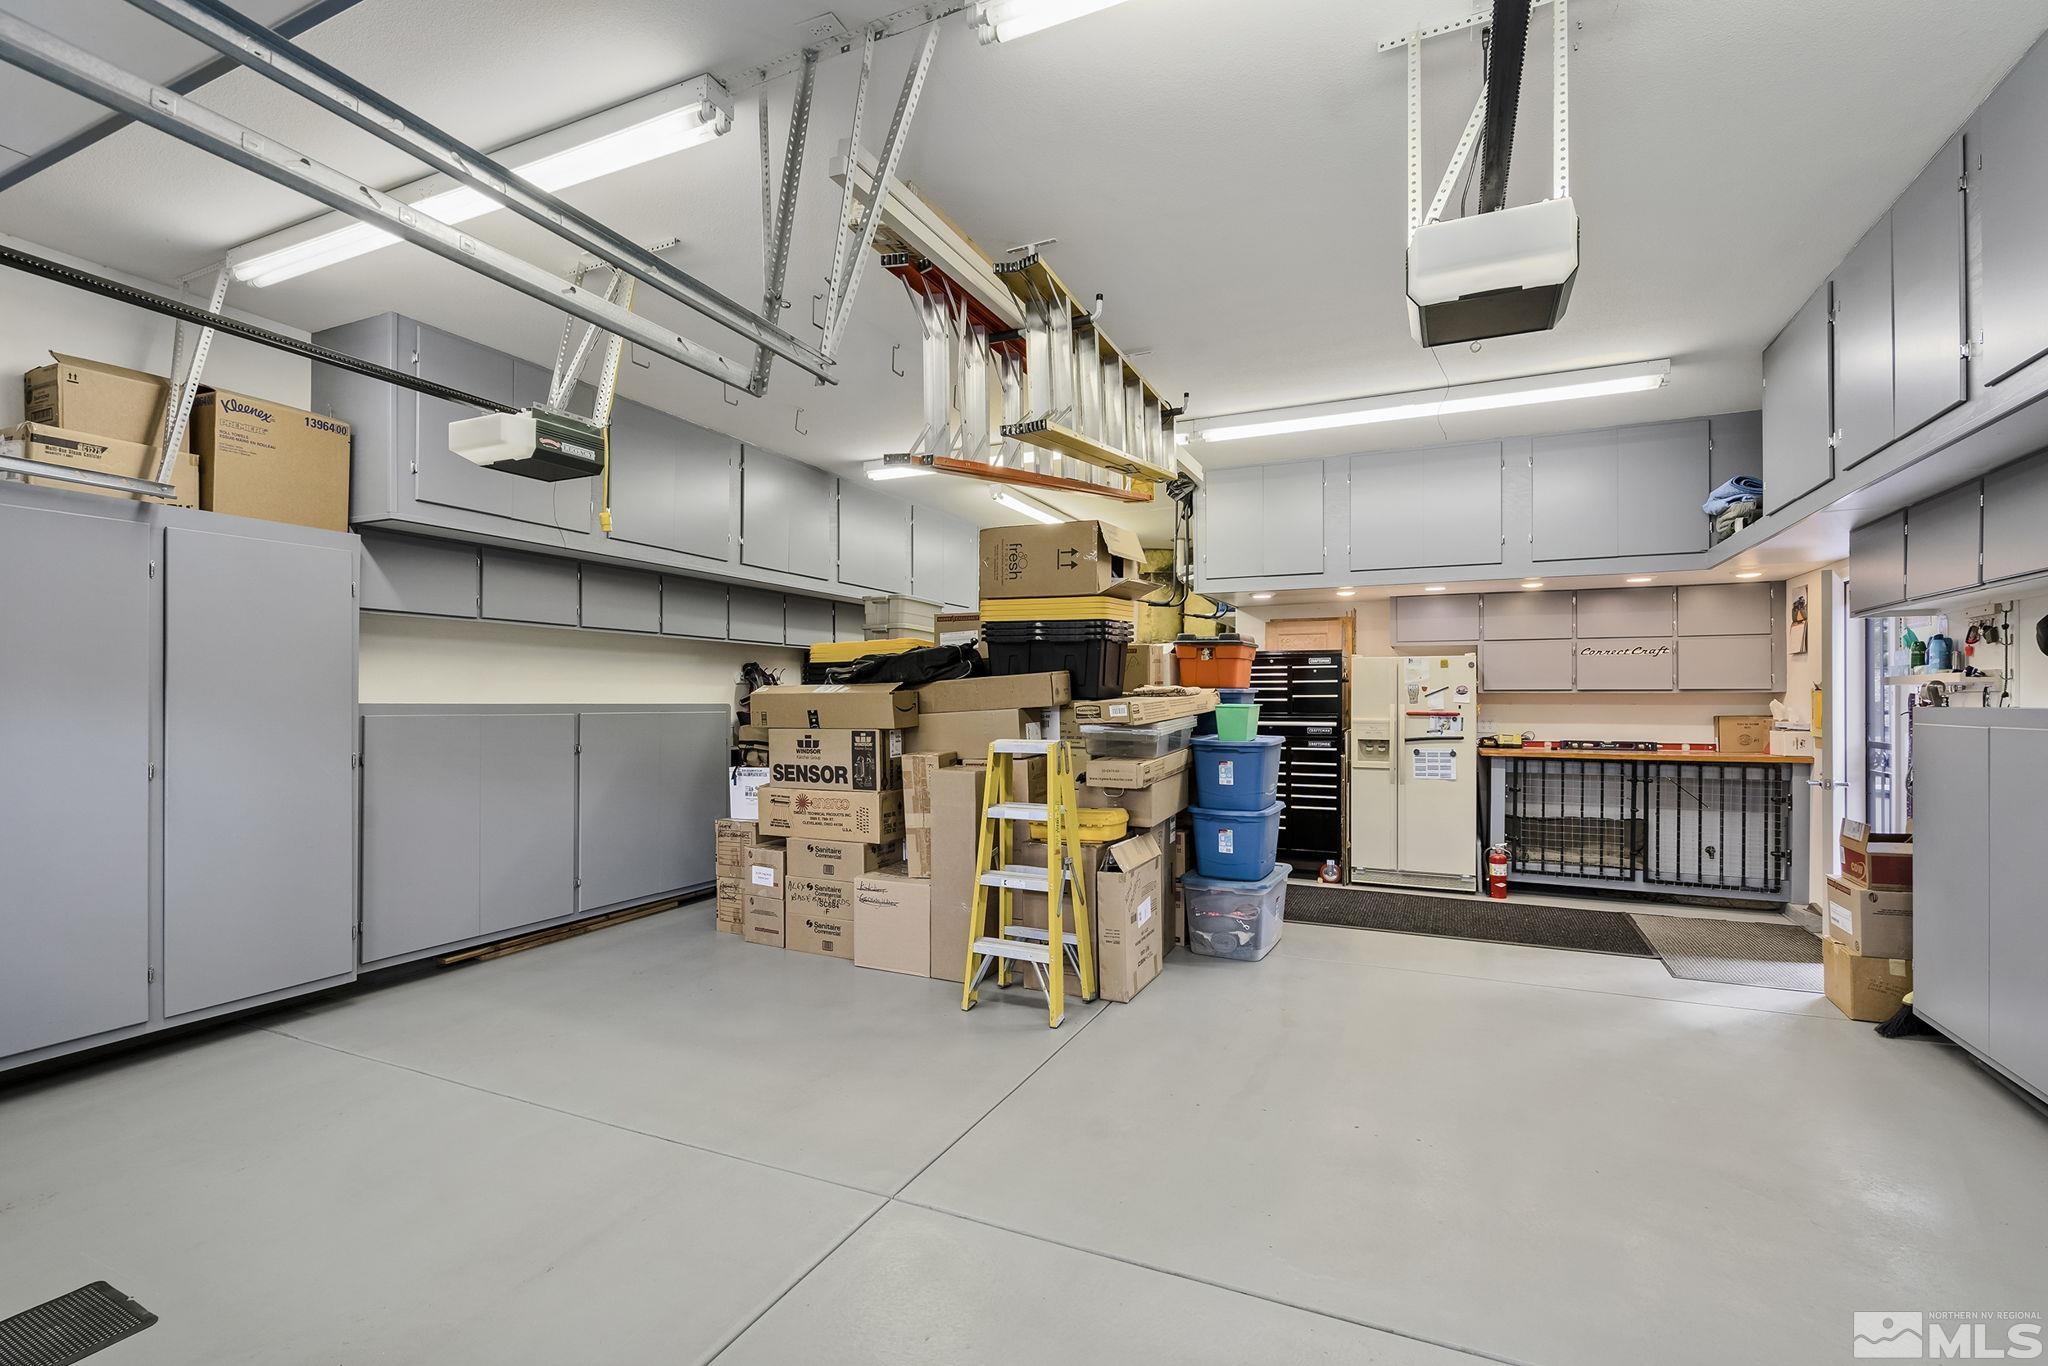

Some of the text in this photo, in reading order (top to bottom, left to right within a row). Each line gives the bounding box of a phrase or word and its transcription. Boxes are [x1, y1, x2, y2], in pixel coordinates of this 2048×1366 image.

[221, 399, 272, 423] Kleenex
[1009, 543, 1022, 580] fresh
[1631, 645, 1670, 658] Craft
[773, 764, 848, 784] SENSOR
[814, 846, 842, 854] Sanitaire
[814, 884, 842, 894] Sanitaire
[814, 922, 841, 932] Sanitaire
[814, 928, 841, 937] Commercial
